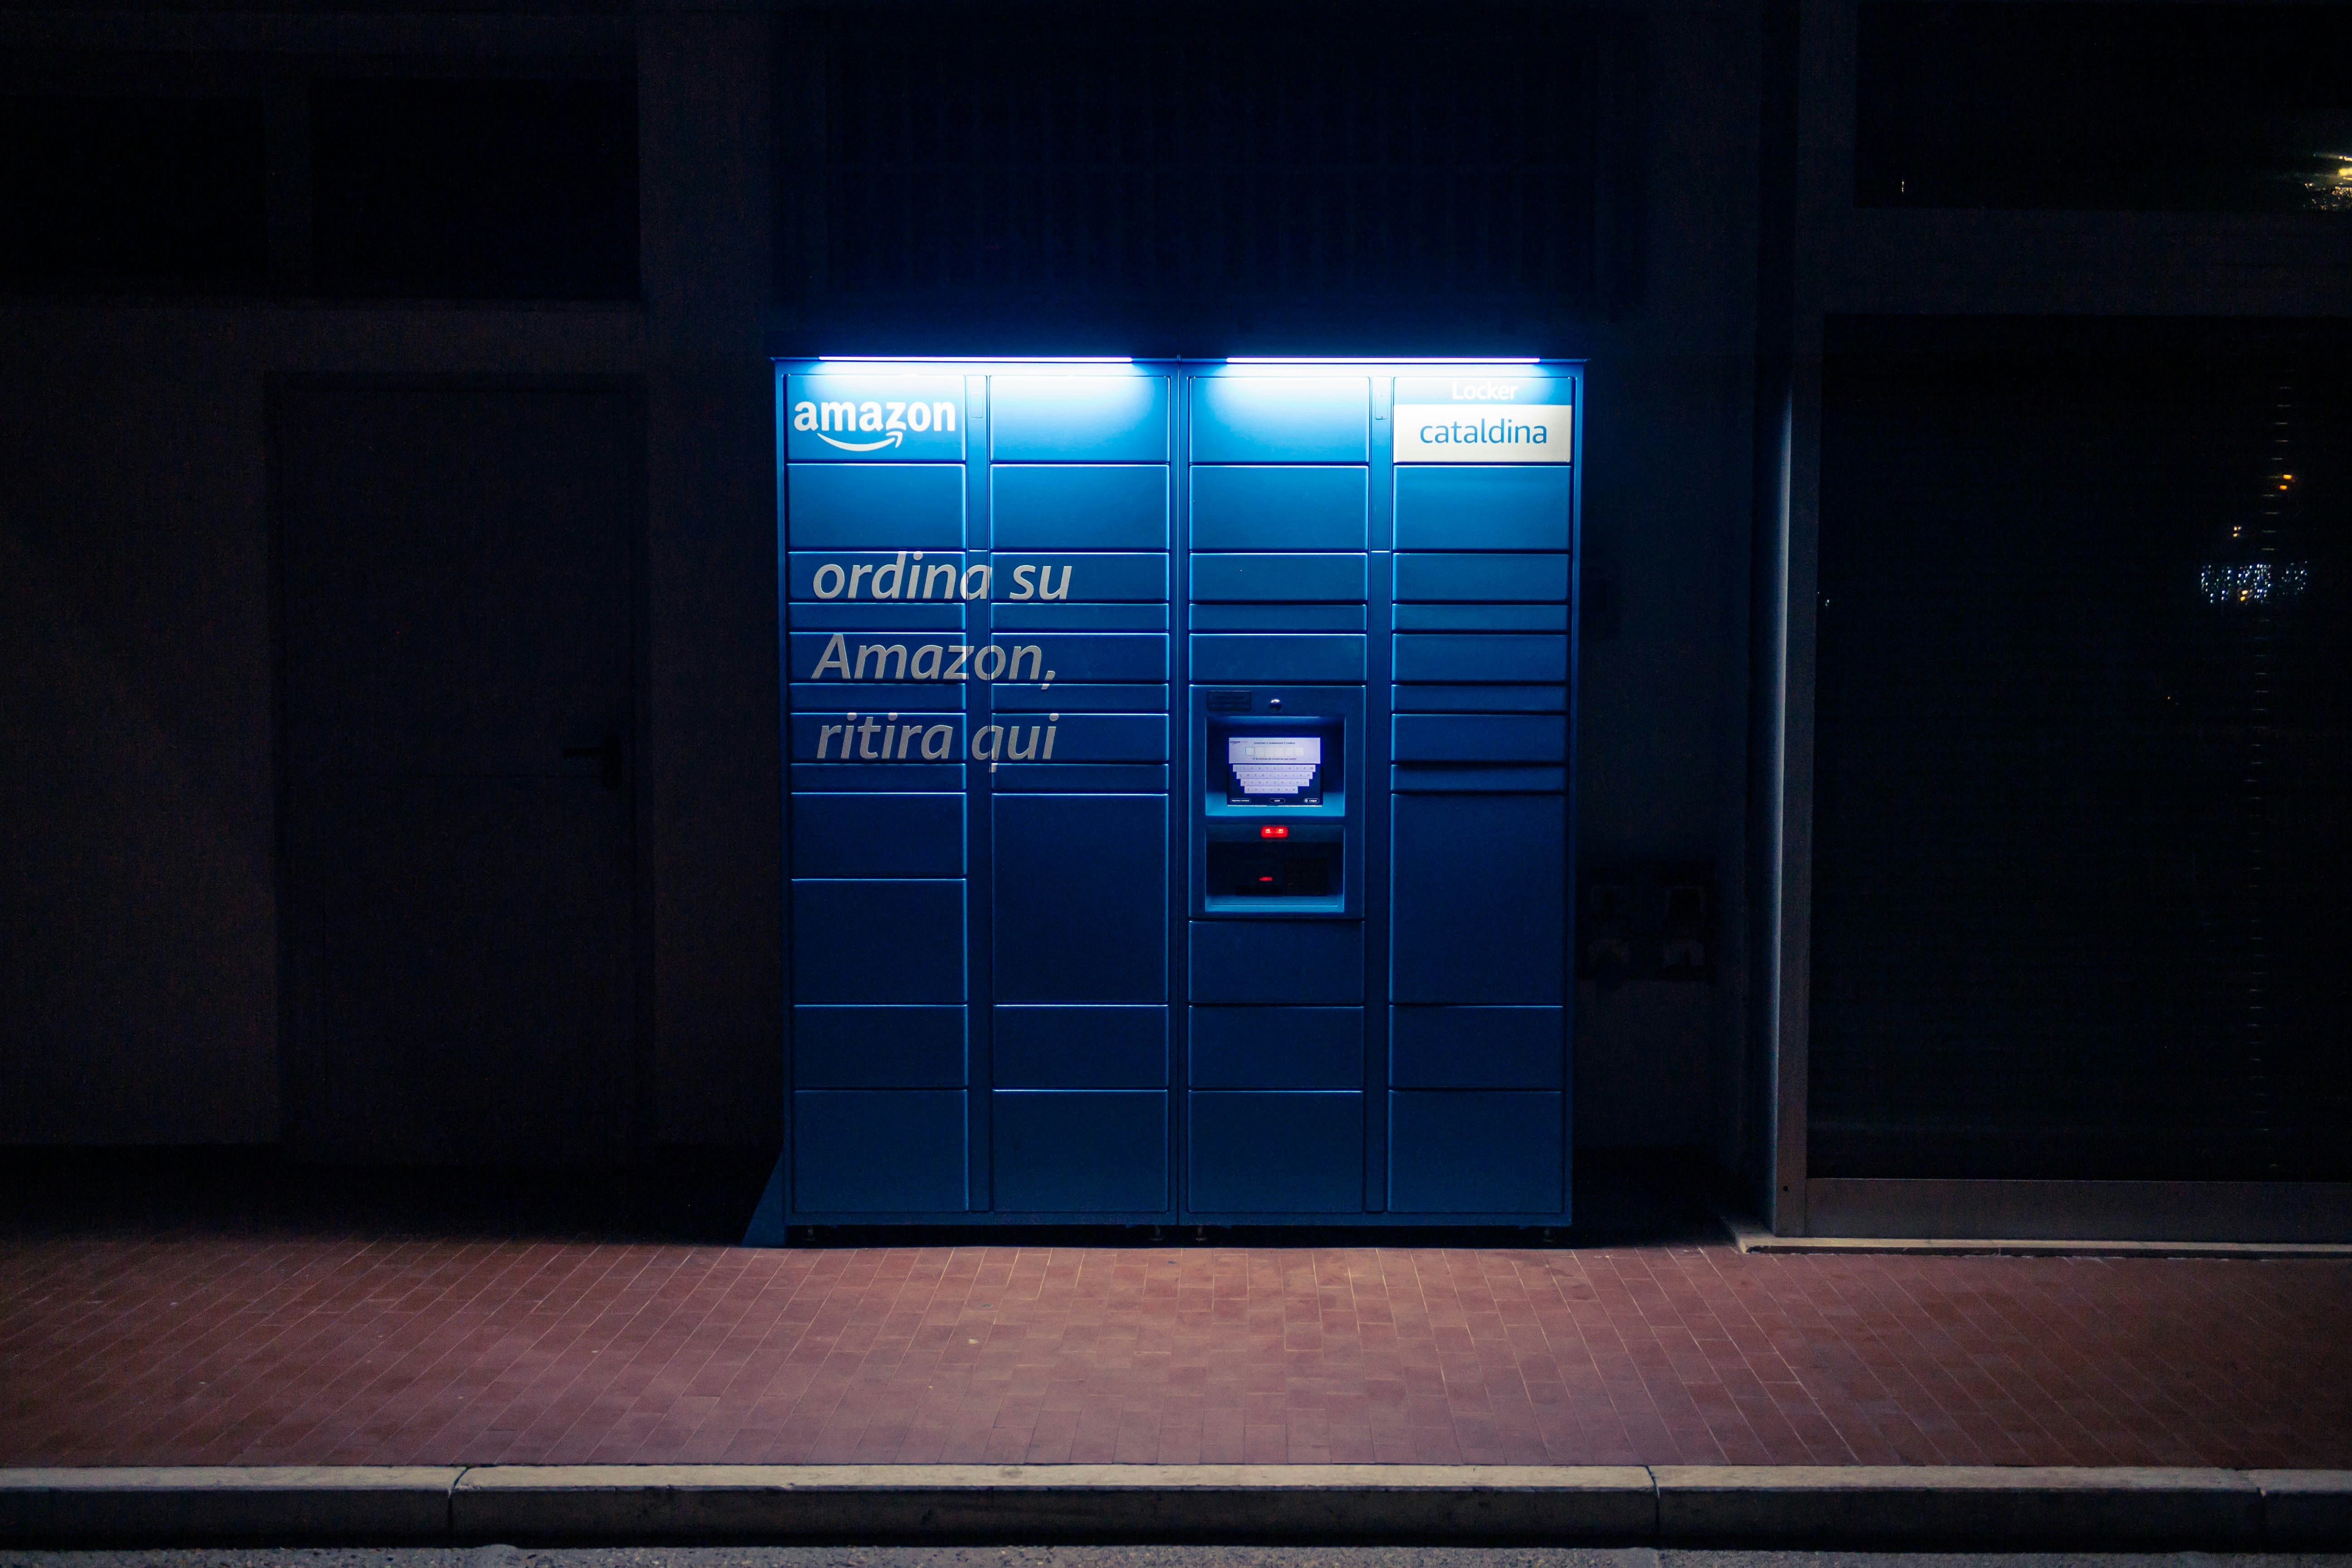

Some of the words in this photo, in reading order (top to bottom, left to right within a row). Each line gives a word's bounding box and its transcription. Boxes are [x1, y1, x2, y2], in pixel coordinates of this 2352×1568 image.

[1452, 381, 1518, 400] Locker
[794, 401, 956, 432] amazon
[1420, 418, 1547, 444] cataldina
[813, 551, 992, 600] ordina
[1009, 565, 1072, 600] su
[811, 633, 1056, 690] Amazon,
[817, 712, 953, 760] ritira
[972, 713, 1059, 773] qui
